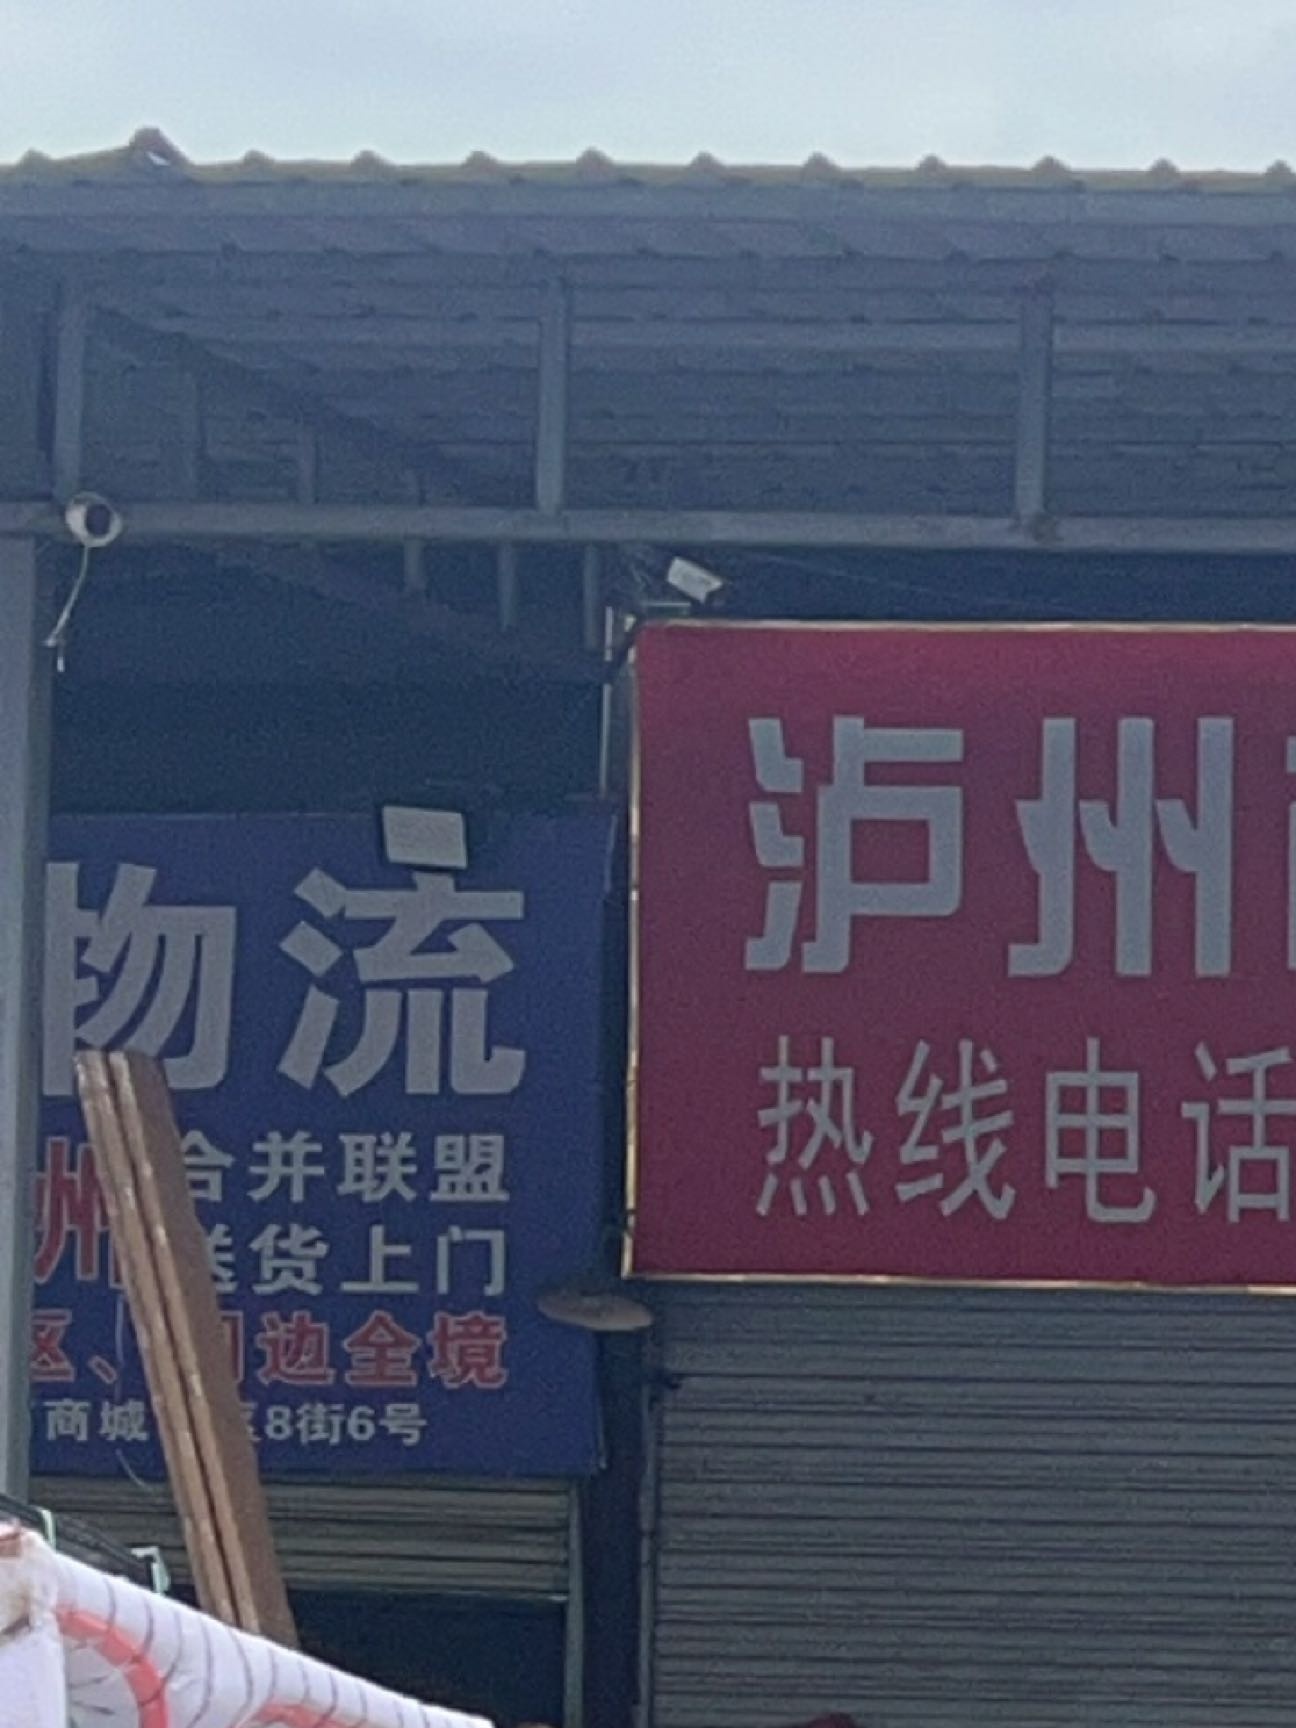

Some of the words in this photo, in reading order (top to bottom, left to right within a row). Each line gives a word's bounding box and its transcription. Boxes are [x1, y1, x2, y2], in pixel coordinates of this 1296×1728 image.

[42, 862, 526, 1097] 物流
[31, 1308, 508, 1389] 区、边全境
